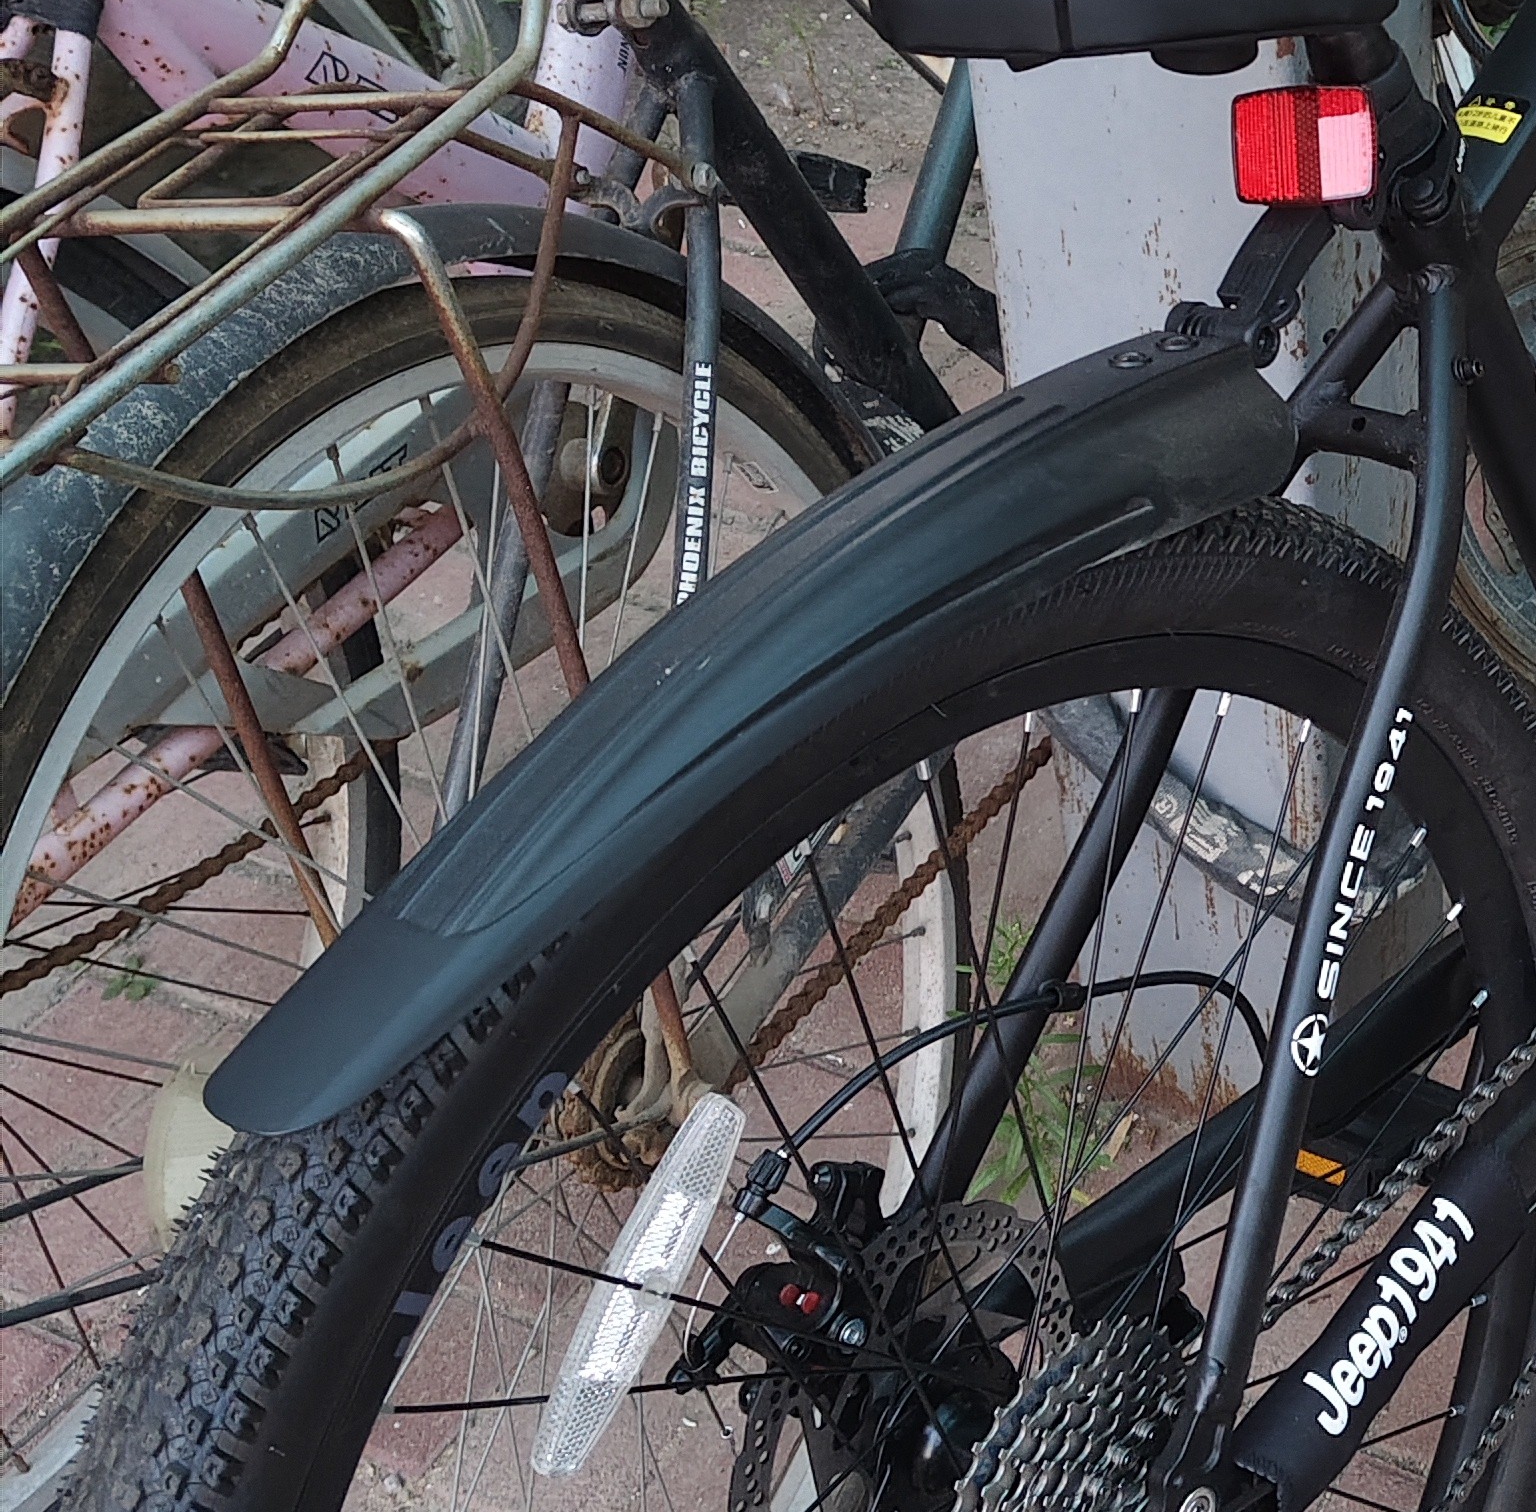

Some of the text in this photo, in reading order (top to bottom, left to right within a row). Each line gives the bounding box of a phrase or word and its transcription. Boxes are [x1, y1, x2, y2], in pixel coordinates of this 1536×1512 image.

[690, 361, 712, 478] BICYCLE
[1317, 707, 1413, 1001] SINCE 1941
